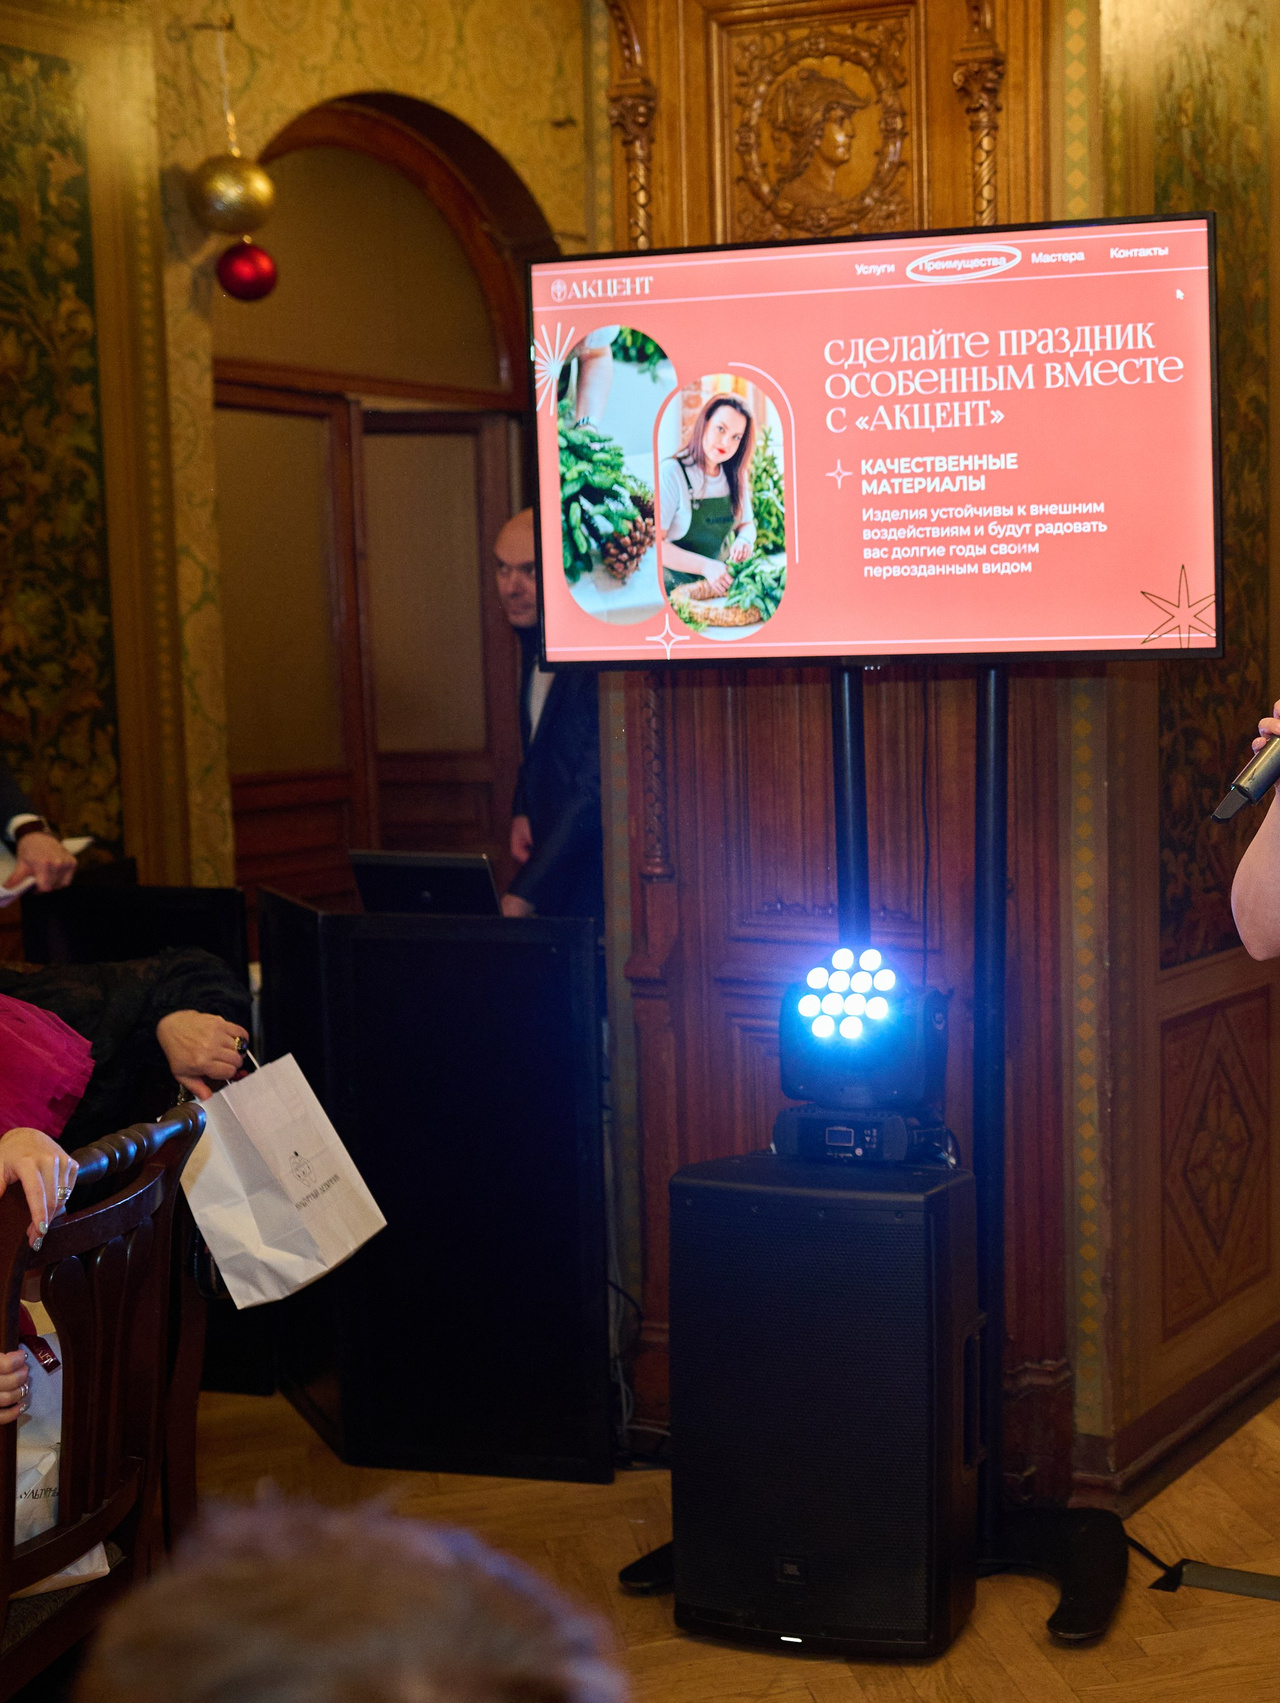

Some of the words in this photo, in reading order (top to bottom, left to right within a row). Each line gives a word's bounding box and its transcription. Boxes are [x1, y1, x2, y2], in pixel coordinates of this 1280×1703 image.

[856, 262, 895, 275] Услуги
[919, 256, 1006, 271] Преимущества
[1032, 250, 1084, 264] Мастера
[1110, 246, 1169, 259] Контакты
[568, 276, 654, 299] АКЦЕНТ
[861, 453, 1018, 475] КАЧЕСТВЕННЫЕ
[862, 475, 985, 495] МАТЕРИАЛЫ
[863, 507, 927, 522] Изделия
[931, 505, 1013, 522] устойчивы
[1018, 505, 1026, 515] к
[1030, 502, 1104, 515] внешним
[863, 526, 970, 540] воздействиям
[975, 526, 983, 536] и
[988, 521, 1031, 538] будут
[1035, 520, 1107, 536] радовать
[864, 547, 888, 559] вас
[892, 545, 945, 560] долгие
[950, 545, 986, 558] годы
[990, 542, 1039, 554] своим
[864, 563, 978, 579] первозданным
[982, 561, 1031, 575] видом
